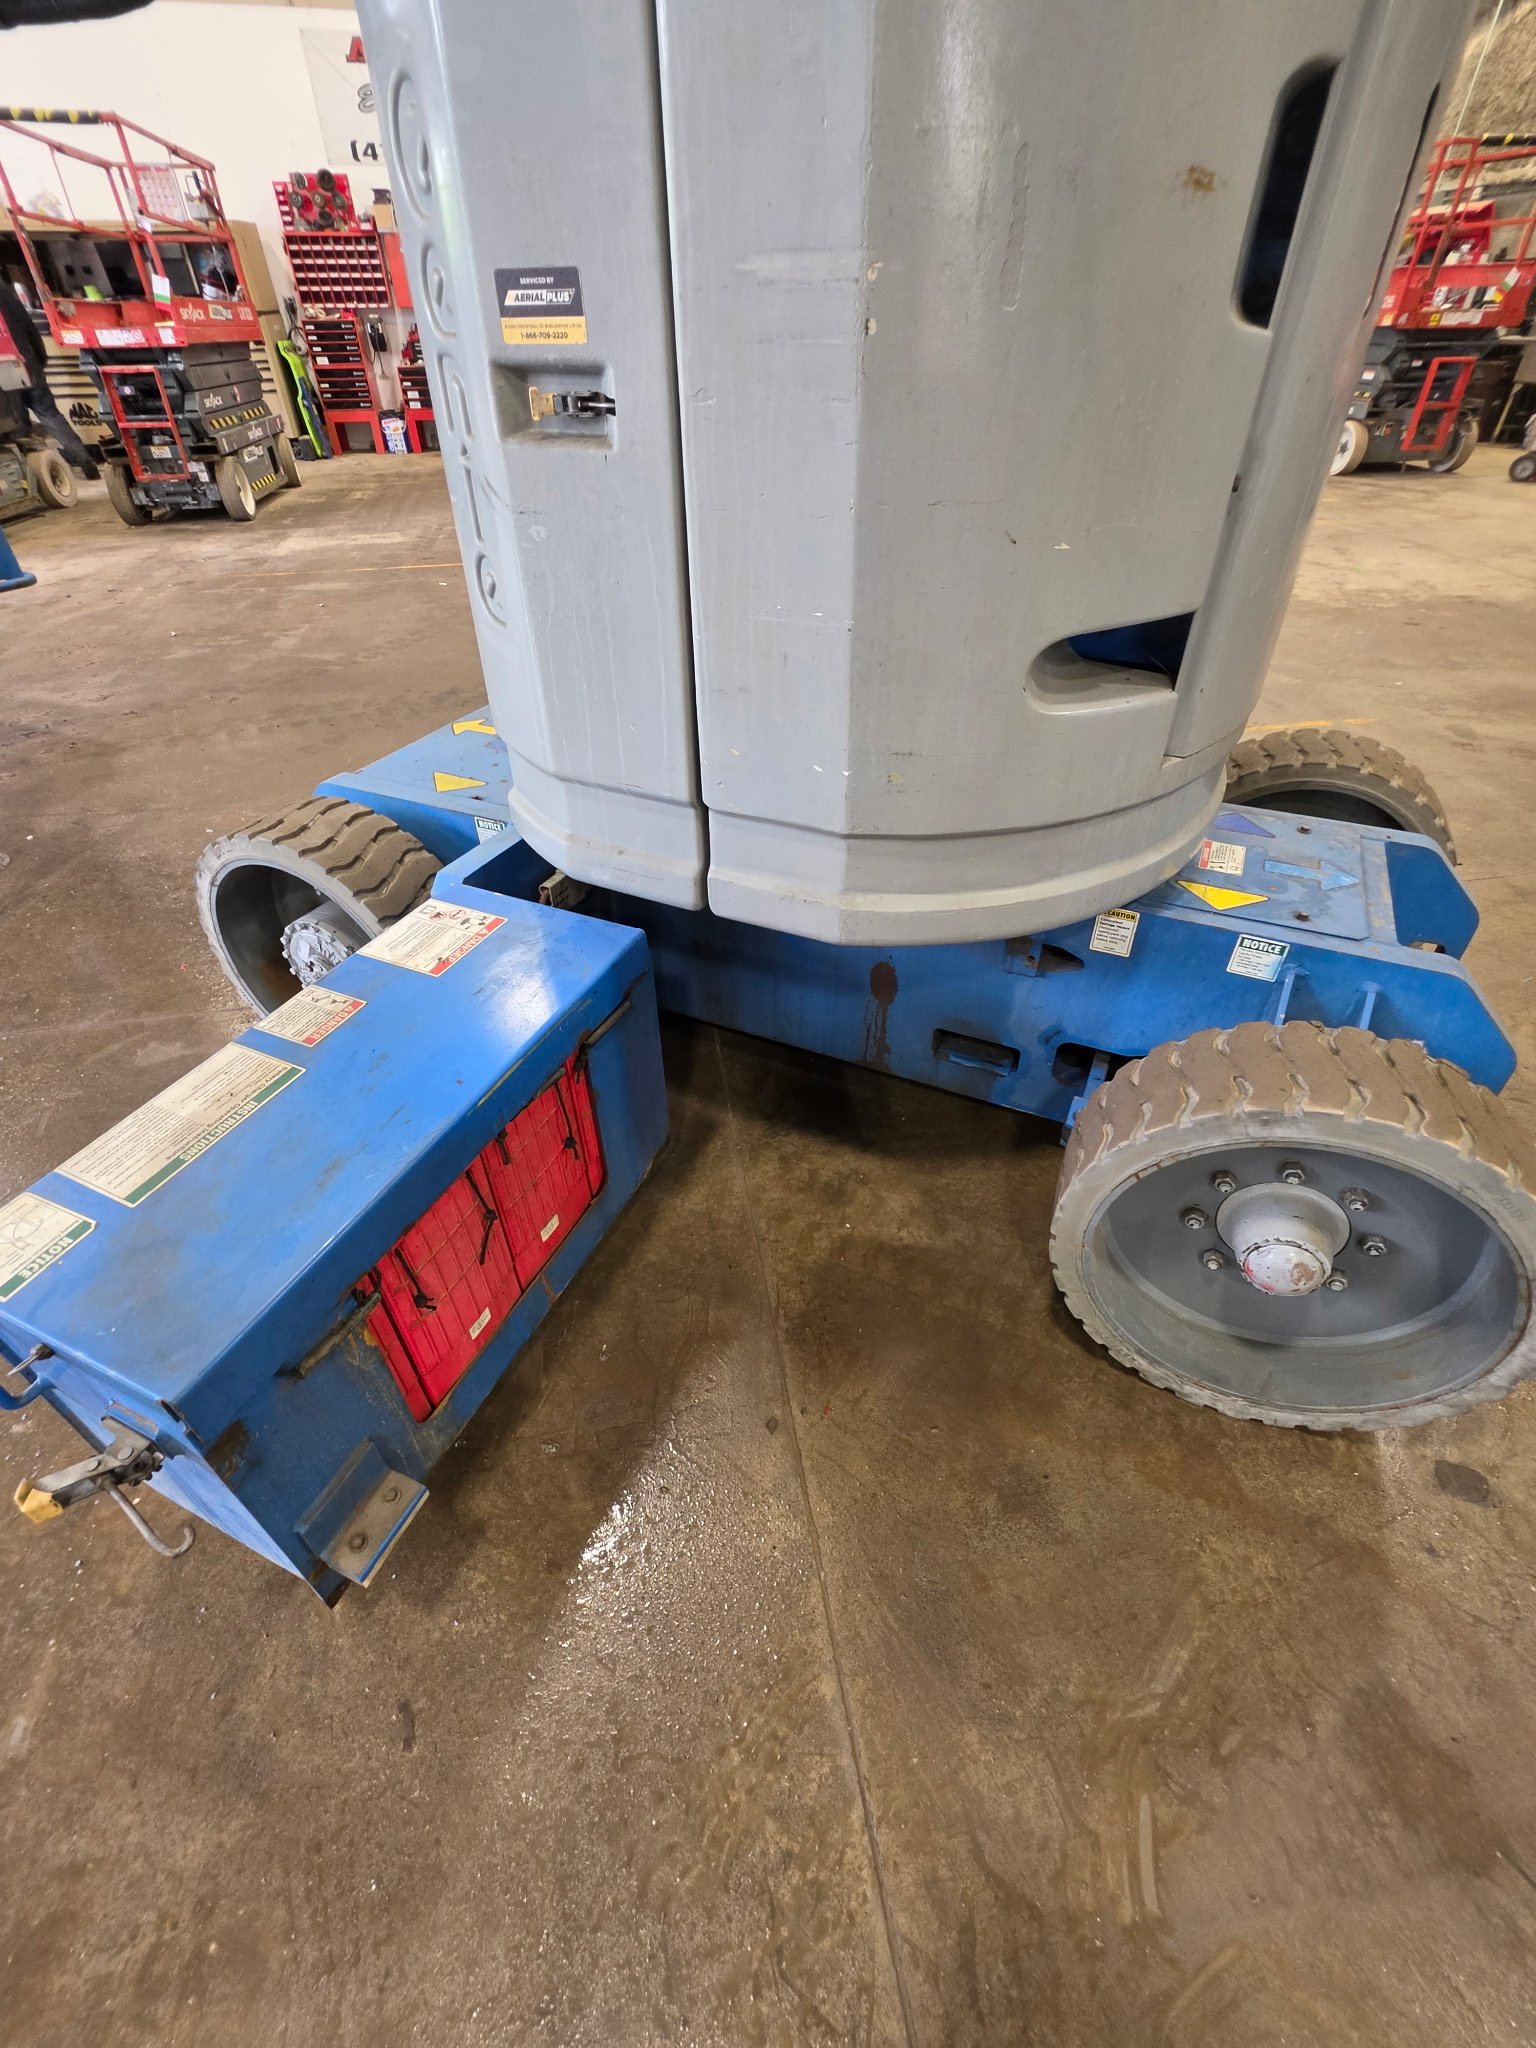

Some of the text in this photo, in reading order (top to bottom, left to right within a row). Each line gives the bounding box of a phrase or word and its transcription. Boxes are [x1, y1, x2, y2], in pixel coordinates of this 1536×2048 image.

[350, 140, 382, 162] (4
[514, 291, 569, 303] AERIAL PLUS
[69, 402, 98, 419] MAC
[1107, 911, 1136, 920] CAUTION
[1242, 939, 1282, 954] NOTICE
[310, 1010, 347, 1040] DANGER
[240, 1084, 266, 1103] Charger
[207, 1103, 240, 1128] Operating
[180, 1100, 259, 1161] INSTRUCTIONS
[166, 1128, 208, 1160] Instructions
[18, 1236, 74, 1279] NOTICE
